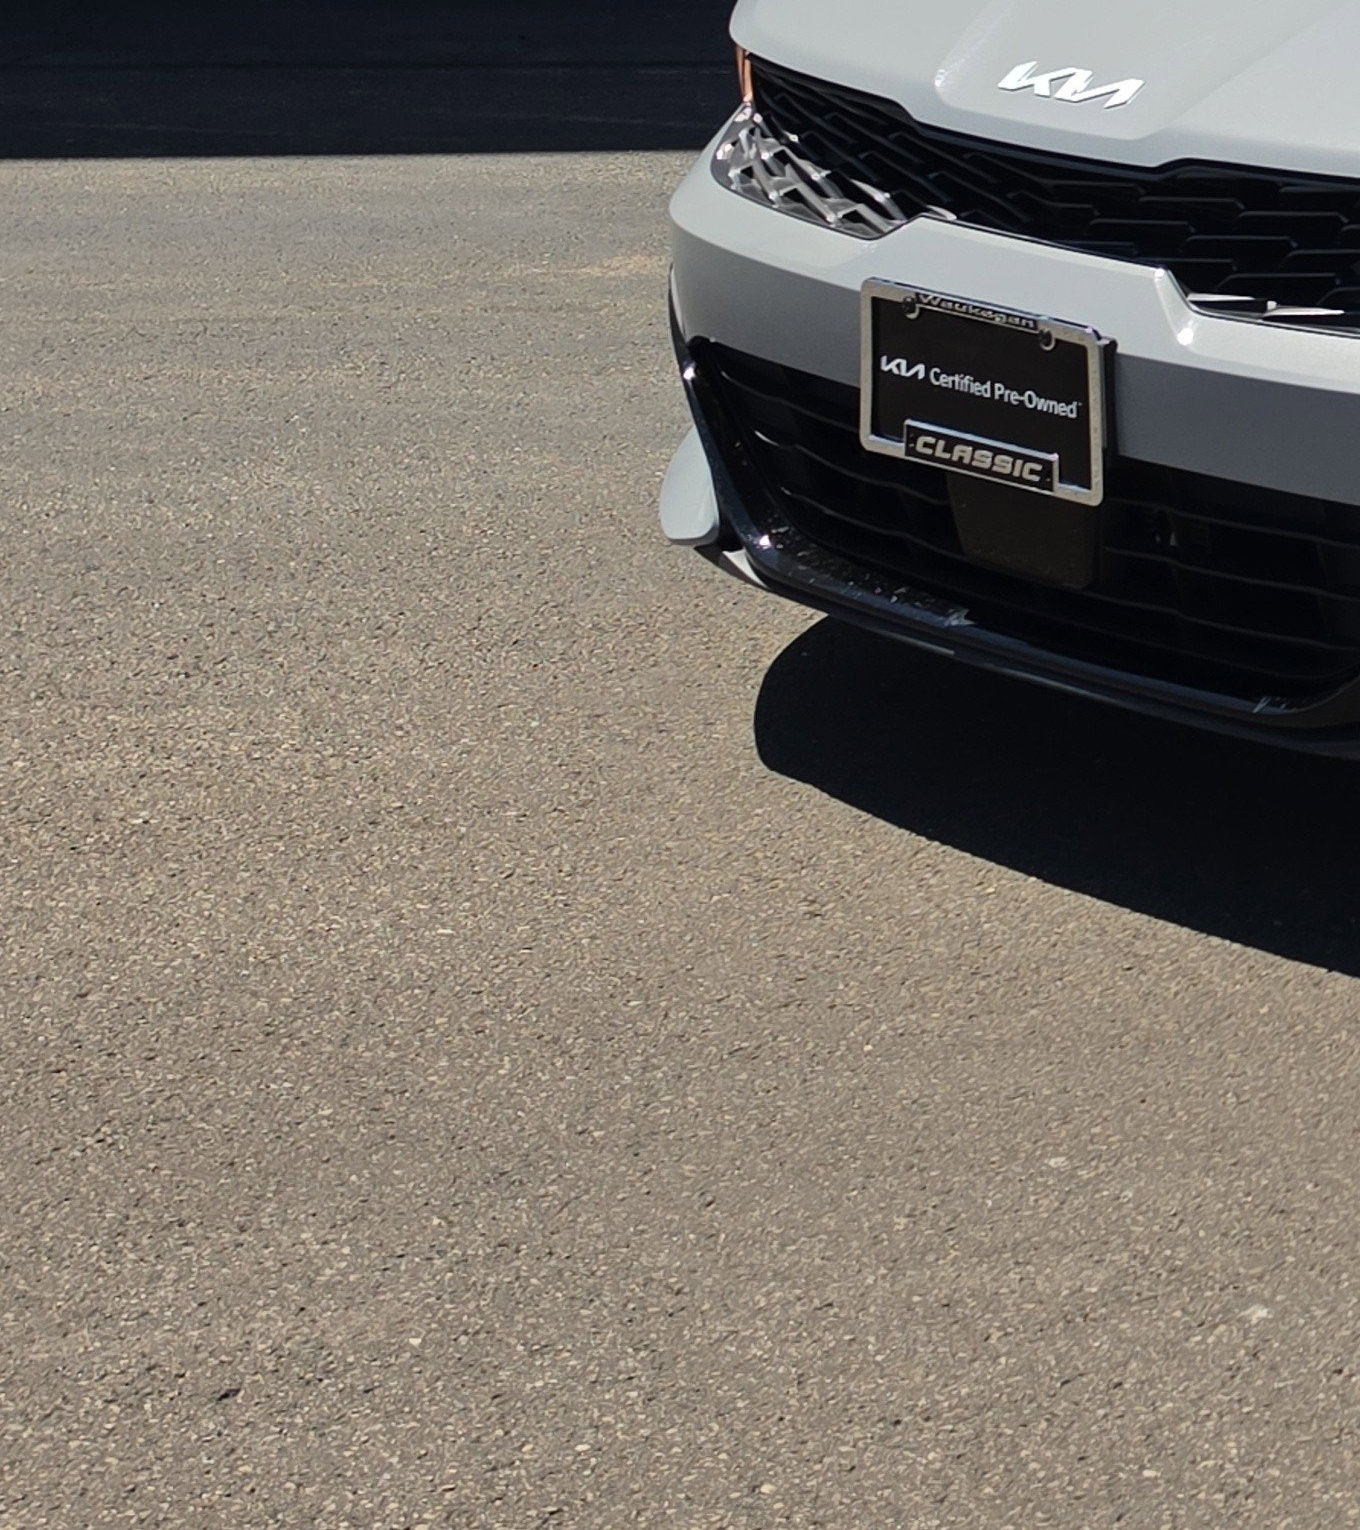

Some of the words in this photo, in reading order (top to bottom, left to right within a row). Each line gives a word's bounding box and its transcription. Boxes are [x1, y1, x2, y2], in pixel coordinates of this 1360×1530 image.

[997, 61, 1145, 109] KIA
[919, 293, 1034, 329] Waukegan
[881, 355, 925, 380] KIA
[929, 368, 991, 398] Certified
[994, 382, 1078, 419] Pre-Owned
[915, 435, 1043, 482] CLASSIC
